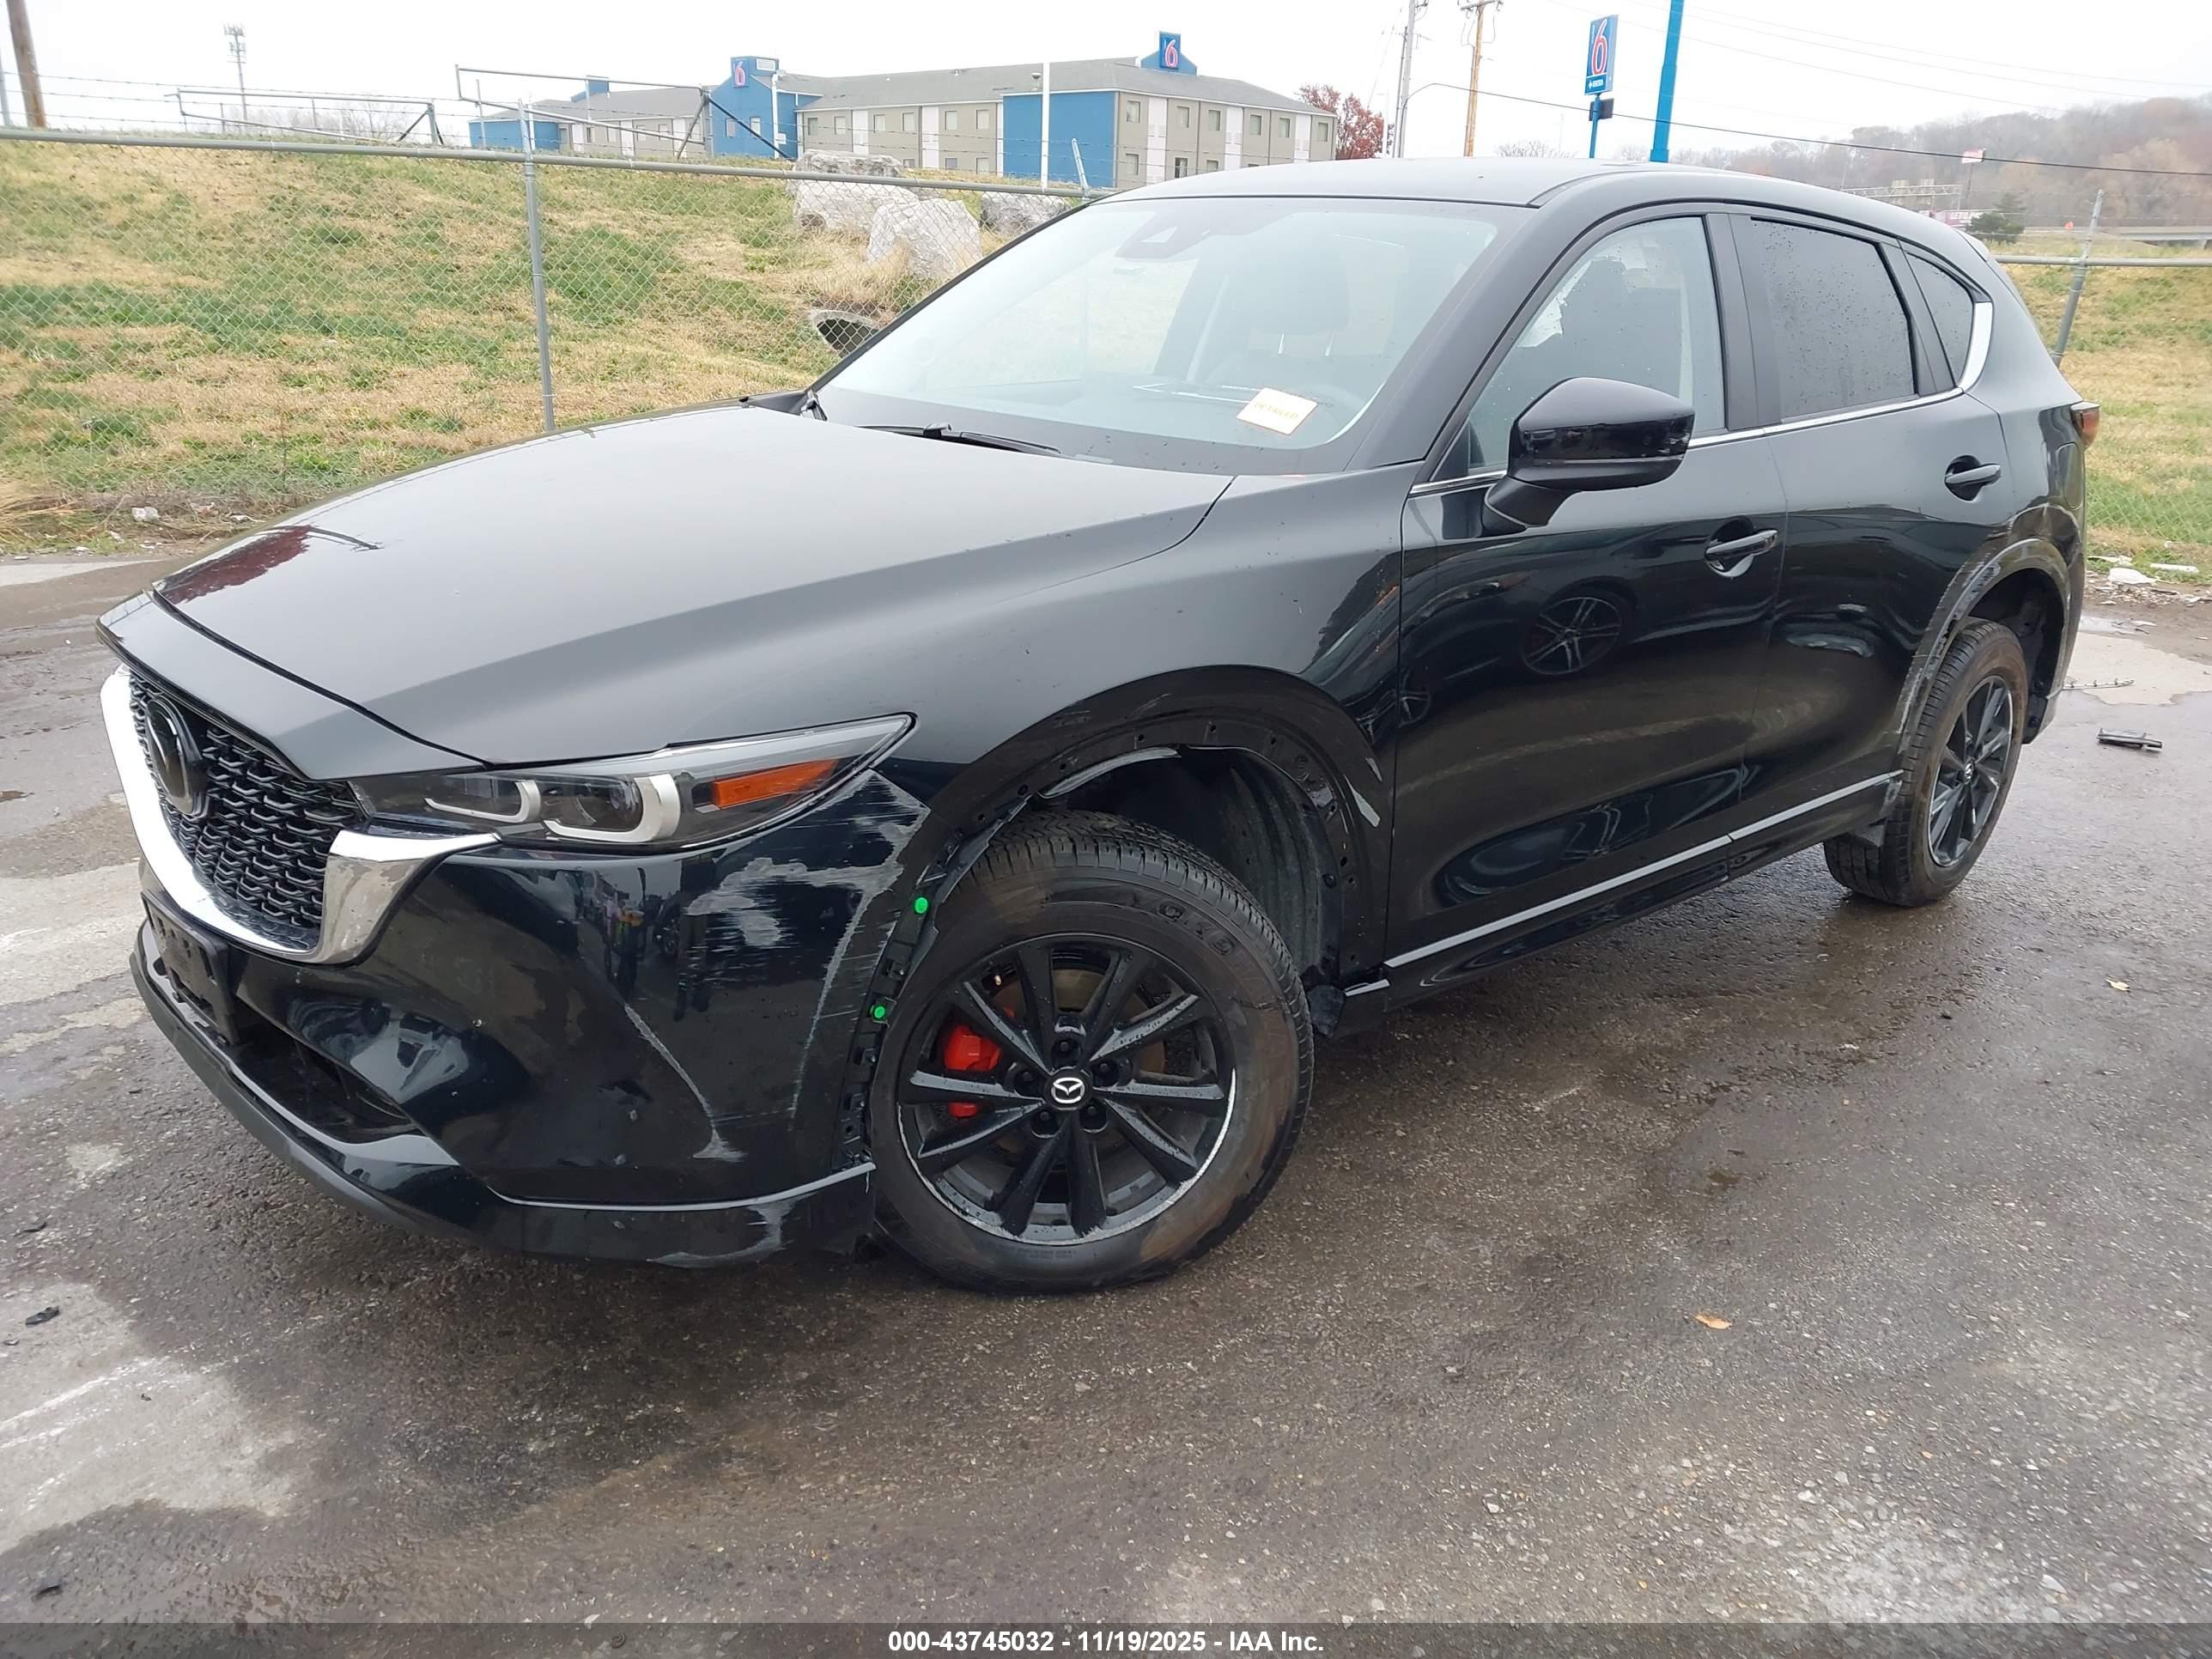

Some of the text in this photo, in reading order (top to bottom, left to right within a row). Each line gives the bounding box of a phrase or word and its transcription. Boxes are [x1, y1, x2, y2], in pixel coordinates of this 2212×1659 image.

[1164, 39, 1178, 68] 6
[1591, 18, 1608, 76] 6
[734, 61, 746, 87] 6
